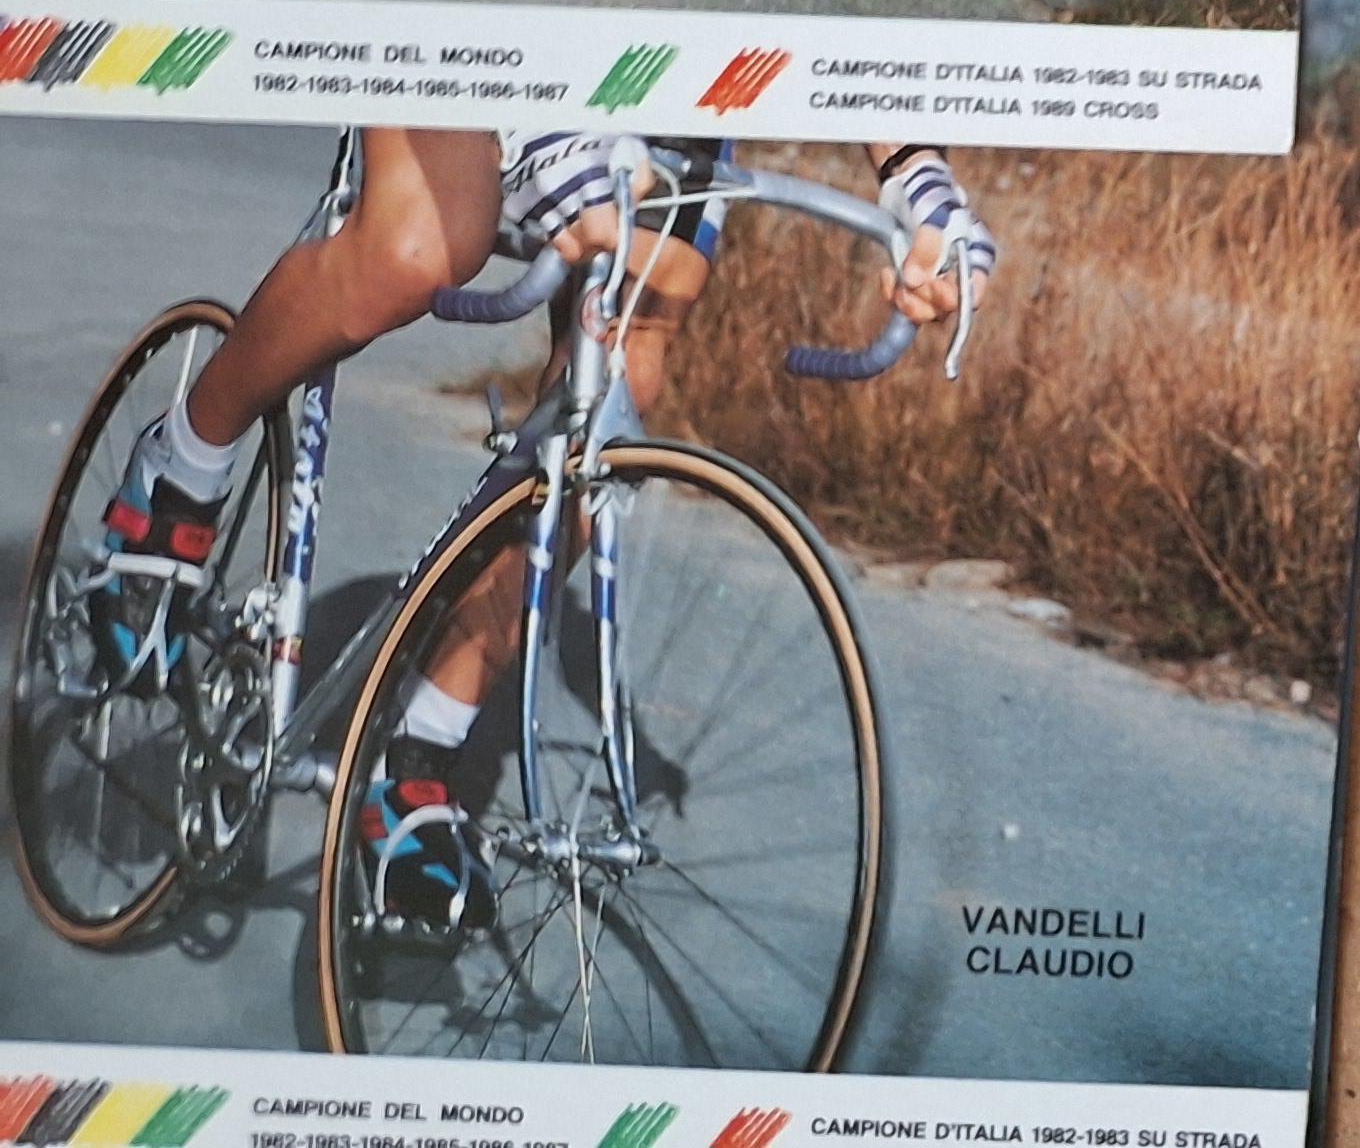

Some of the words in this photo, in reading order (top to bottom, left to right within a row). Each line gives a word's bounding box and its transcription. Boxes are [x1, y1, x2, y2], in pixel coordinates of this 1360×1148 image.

[254, 41, 371, 61] CAMPIONE
[383, 45, 425, 63] DEL
[440, 47, 523, 67] MONDO
[811, 58, 925, 79] CAMPIONE
[935, 63, 1023, 83] D'ITALIA
[1138, 70, 1168, 88] SU
[1175, 71, 1262, 91] STRADA
[809, 91, 923, 112] CAMPIONE
[933, 95, 1021, 115] D'ITALIA
[1083, 100, 1159, 120] CROSS
[962, 906, 1145, 941] VANDELLI
[966, 945, 1134, 980] CLAUDIO
[253, 1098, 371, 1118] CAMPIONE
[384, 1102, 426, 1121] DEL
[440, 1104, 524, 1124] MONDO
[811, 1117, 927, 1139] CAMPIONE
[934, 1122, 1023, 1143] D'ITALIA
[1032, 1126, 1129, 1146] 1982-1983
[1137, 1129, 1167, 1148] SU
[1175, 1130, 1262, 1148] STRADA
